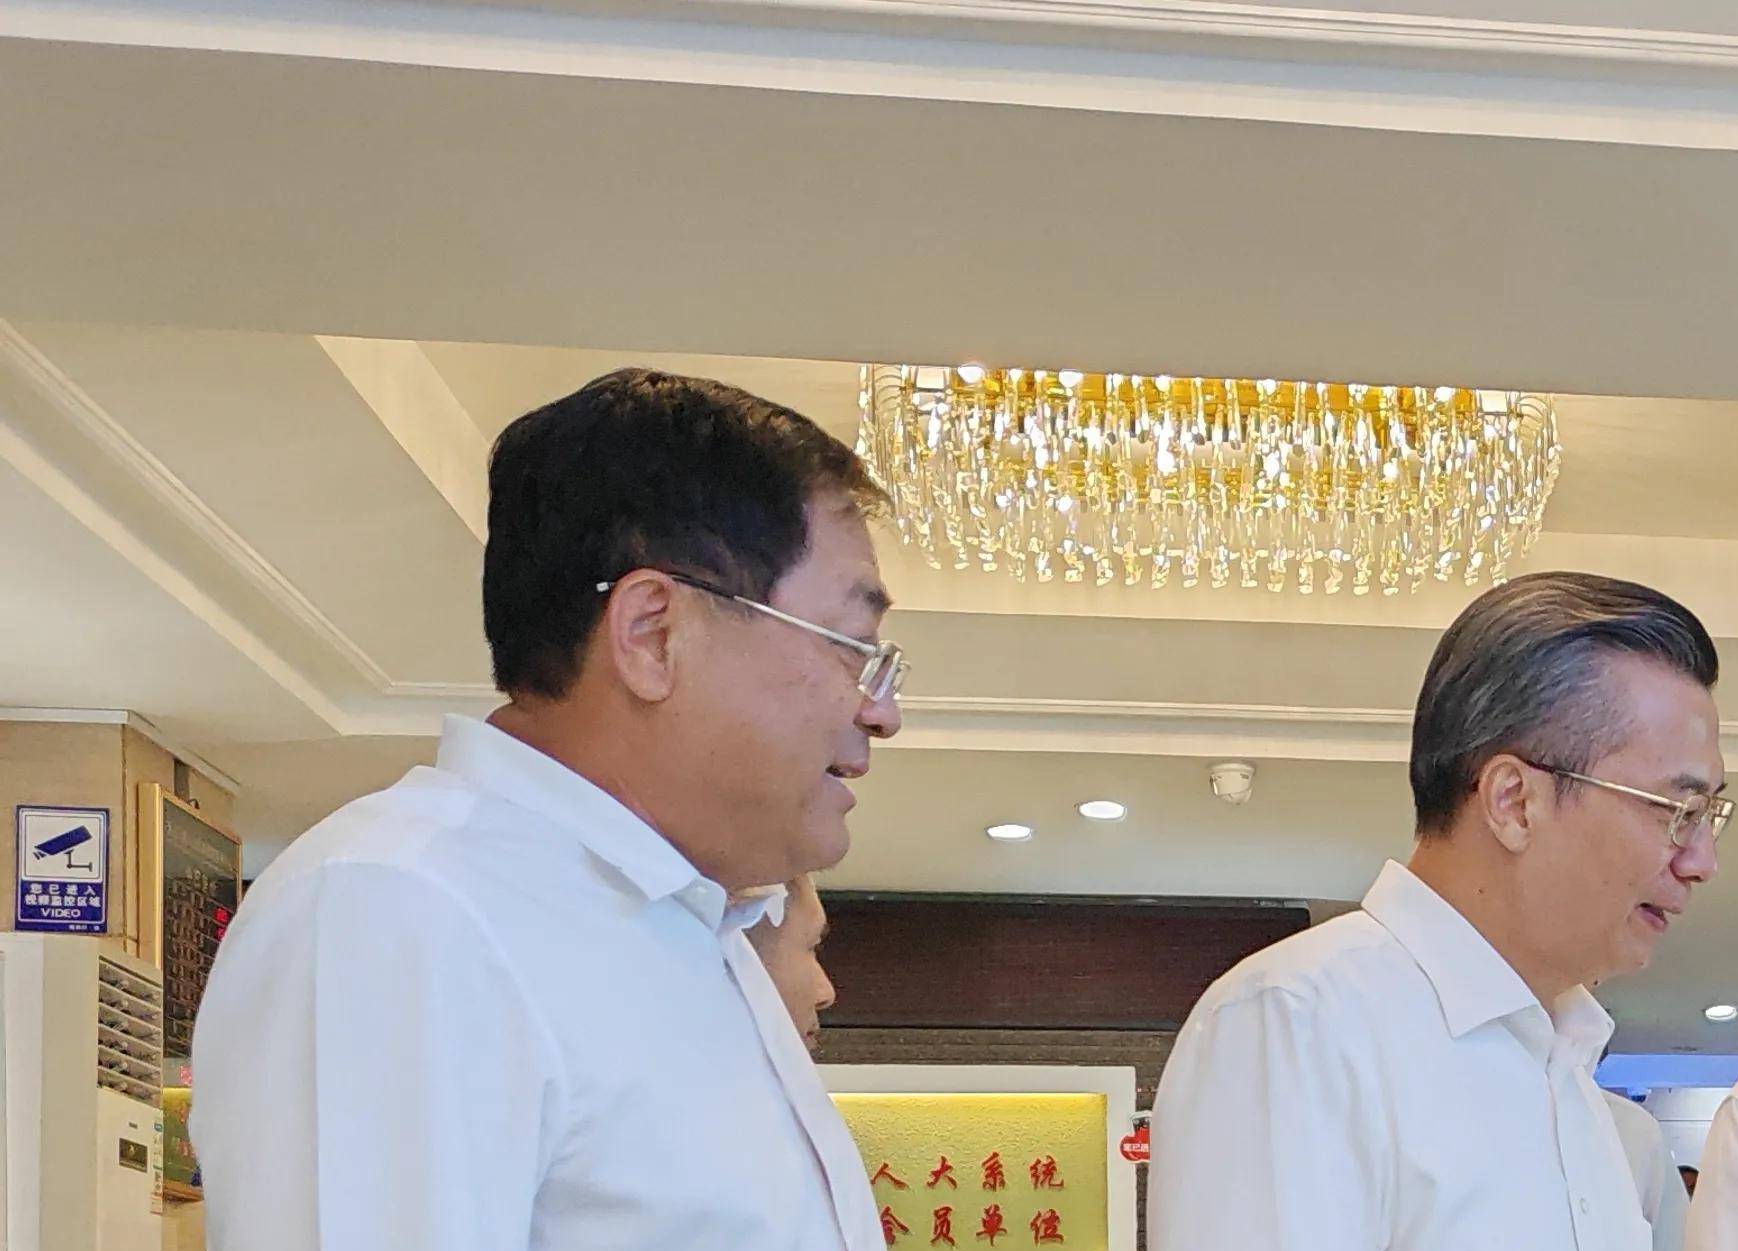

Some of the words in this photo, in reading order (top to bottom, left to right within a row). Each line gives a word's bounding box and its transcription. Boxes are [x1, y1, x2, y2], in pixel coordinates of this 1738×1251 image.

[30, 883, 96, 896] 您已进入
[41, 908, 81, 918] VIDEO
[870, 1150, 1066, 1192] 人大系统
